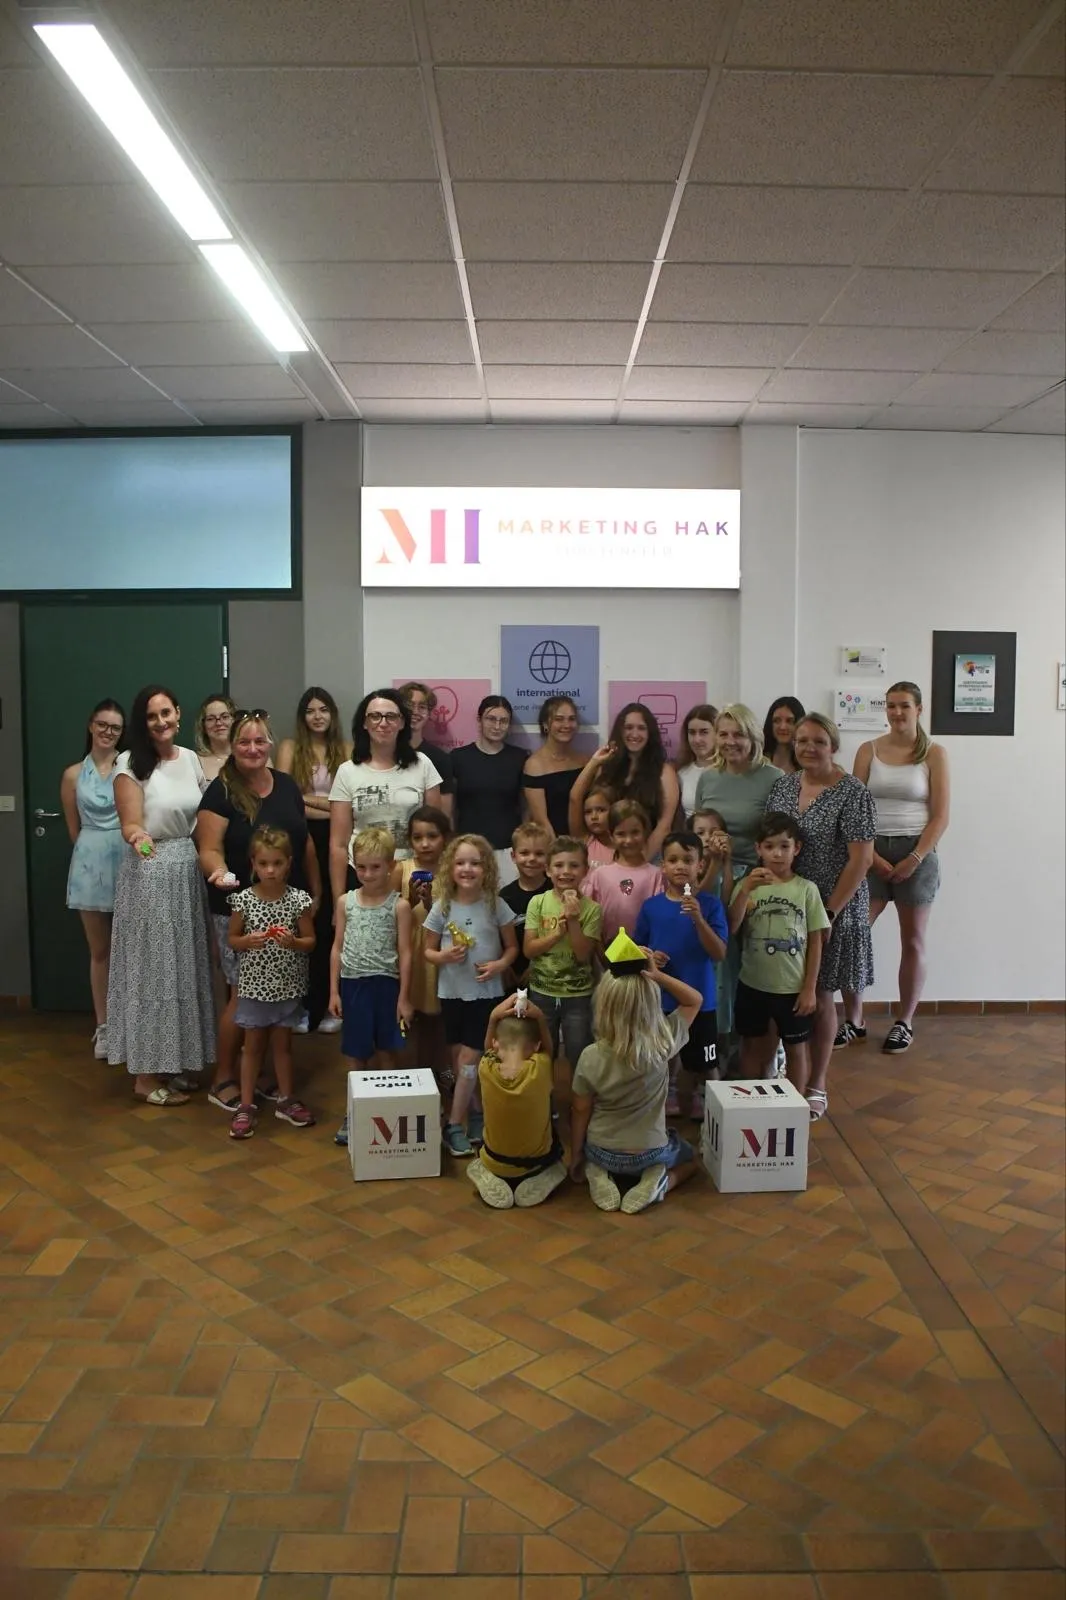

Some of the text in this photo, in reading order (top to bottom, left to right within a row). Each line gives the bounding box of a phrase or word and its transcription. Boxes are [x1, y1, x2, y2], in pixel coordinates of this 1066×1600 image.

[497, 519, 730, 537] MARKETING HAK
[516, 688, 581, 698] international
[703, 1043, 717, 1062] 10
[369, 1114, 426, 1146] MH
[738, 1127, 796, 1158] MH
